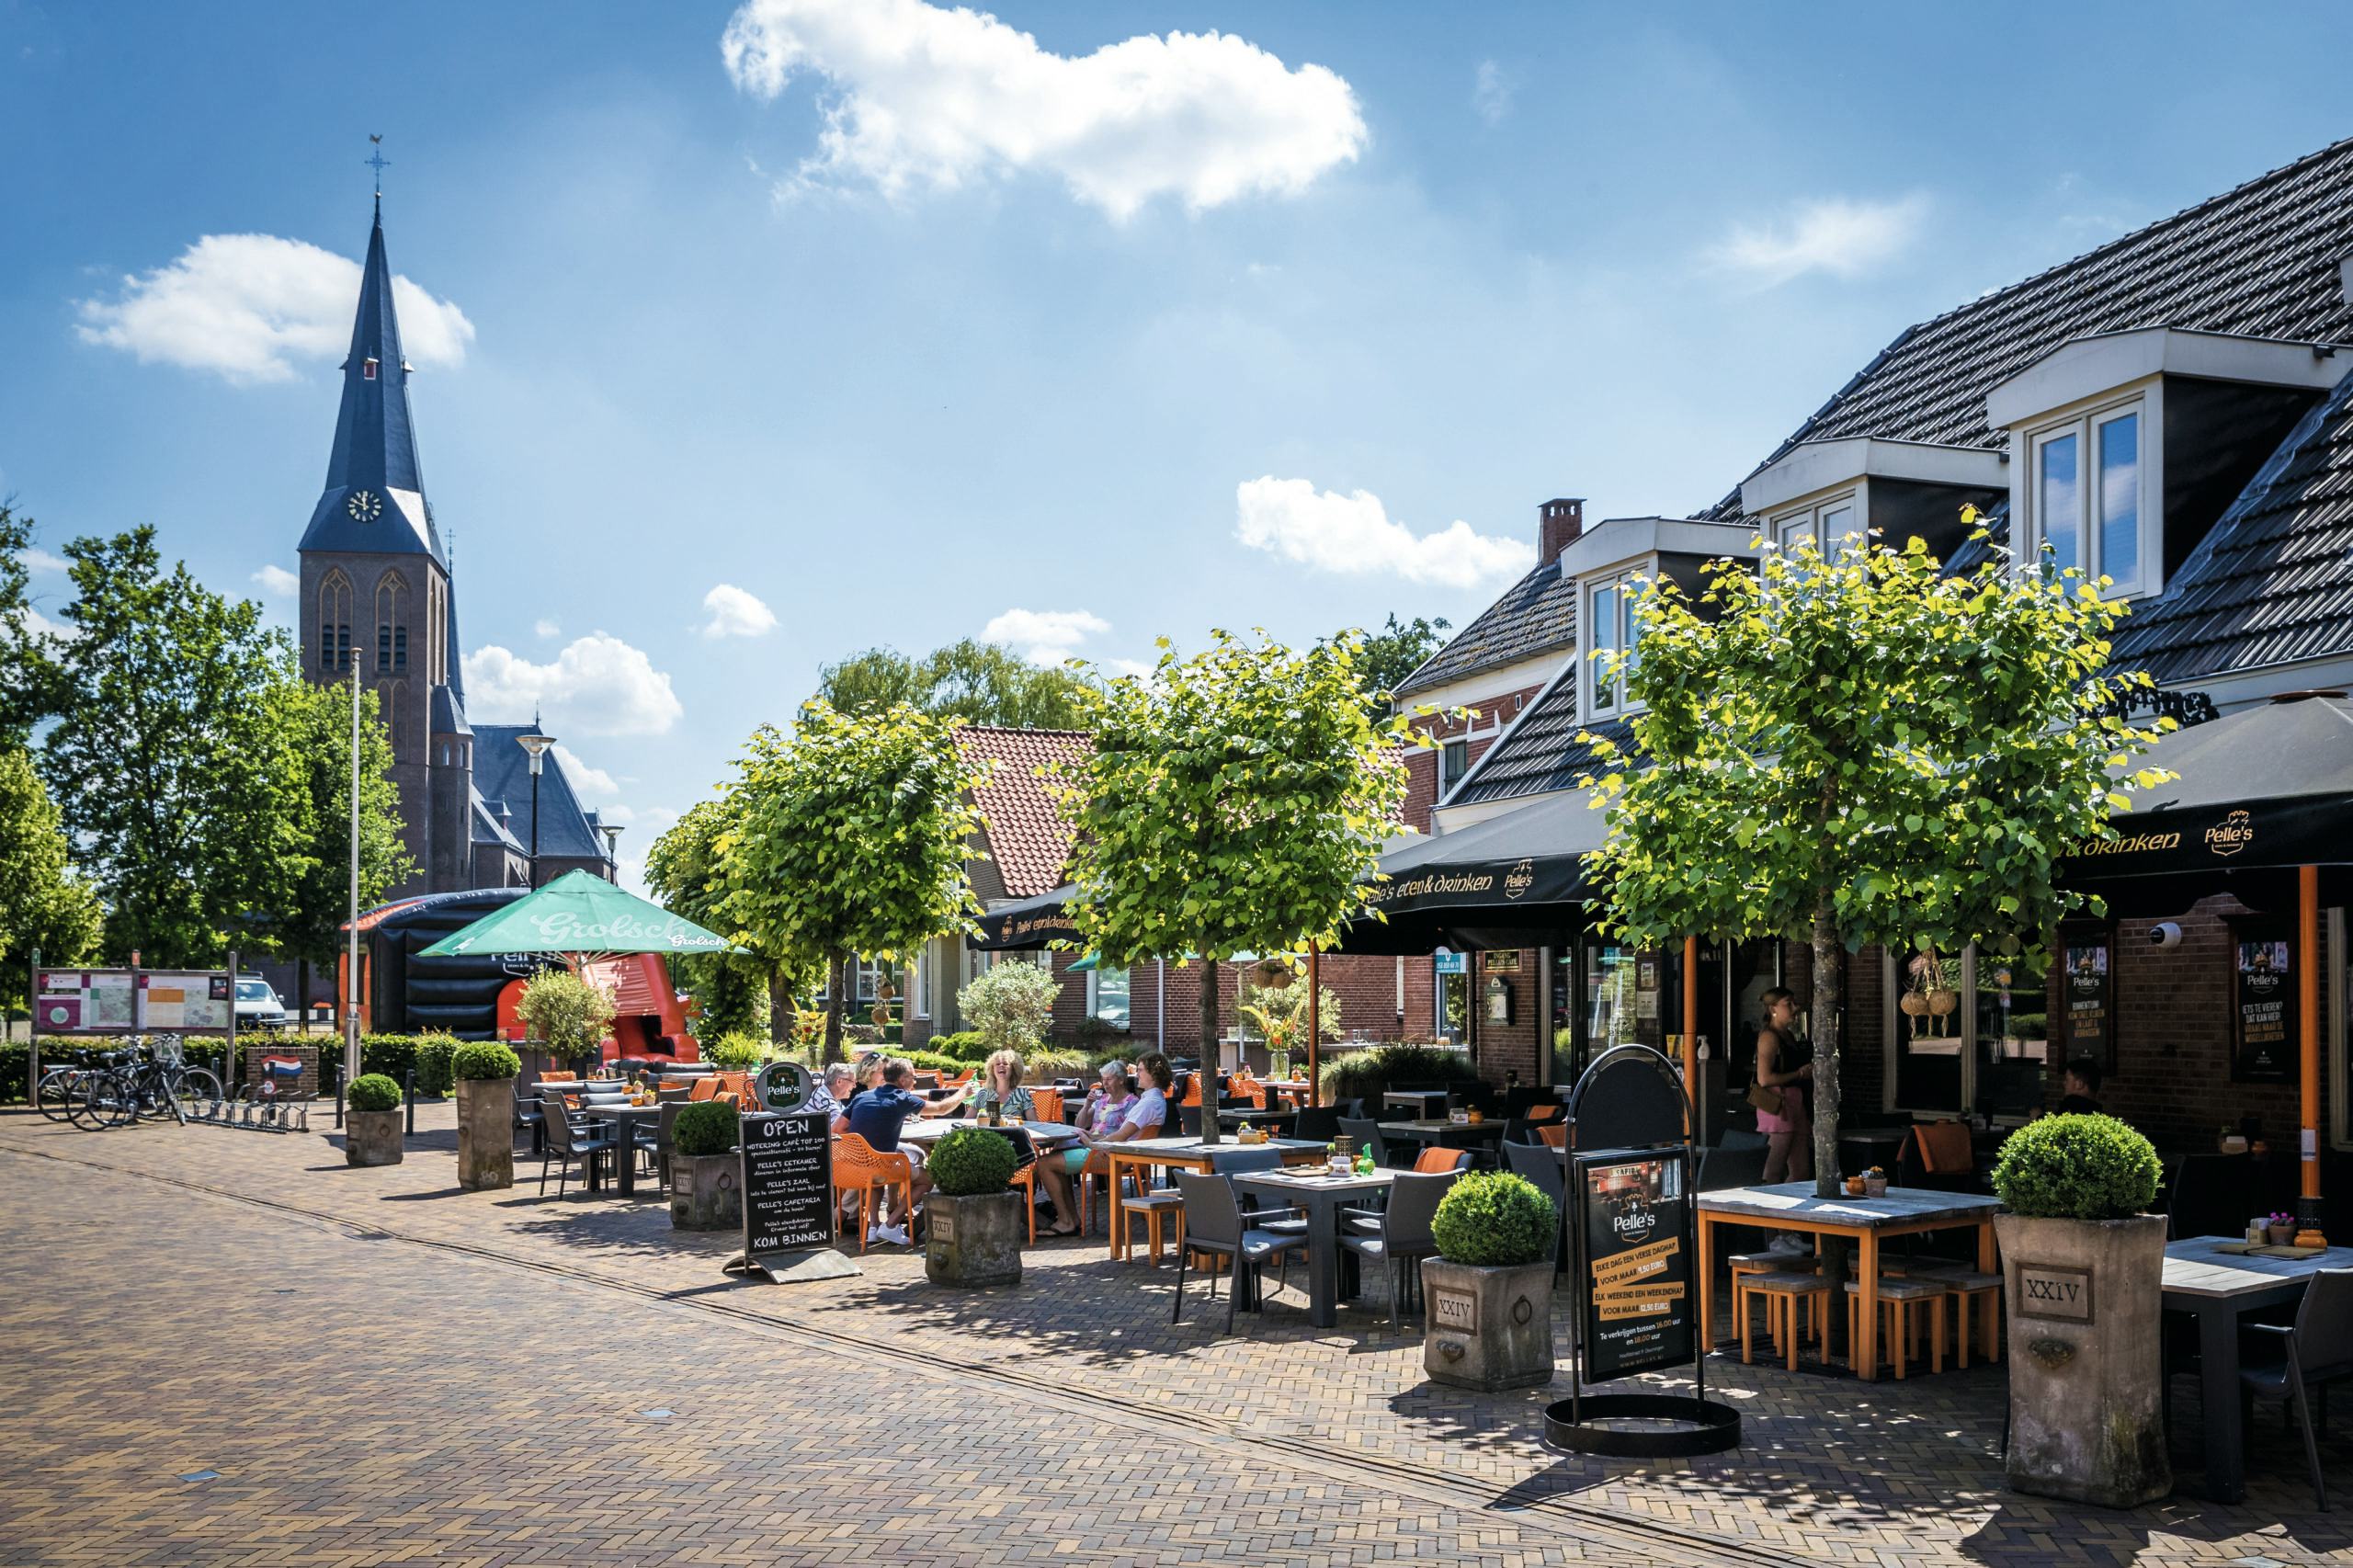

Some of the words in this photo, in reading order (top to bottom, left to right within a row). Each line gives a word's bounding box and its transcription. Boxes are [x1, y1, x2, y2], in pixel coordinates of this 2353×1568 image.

[2204, 825, 2253, 845] Pelle's
[1505, 874, 1533, 889] Pelle's
[1364, 884, 1394, 904] elle's
[530, 912, 689, 945] Grolsch
[667, 934, 728, 949] Grolsch
[2073, 977, 2099, 986] Pelle's
[2247, 974, 2279, 986] Pelle's
[767, 1085, 801, 1096] Pelle's
[763, 1119, 809, 1137] OPEN
[746, 1142, 780, 1150] NOTERING
[756, 1160, 782, 1169] PELLE'S
[784, 1157, 817, 1166] EETKAMER
[767, 1180, 791, 1188] PELLE'S
[793, 1177, 811, 1186] ZAAL
[756, 1200, 782, 1210] PELLE'S
[783, 1197, 821, 1206] CAFETARIA
[933, 1220, 951, 1234] XXIV
[1613, 1212, 1655, 1233] Pelle's
[754, 1236, 779, 1248] KOM
[782, 1230, 827, 1245] BINNEN
[1596, 1263, 1609, 1272] ELKE
[1610, 1258, 1623, 1268] DAG
[1623, 1255, 1634, 1264] EEN
[1634, 1249, 1652, 1260] VERSE
[1652, 1242, 1676, 1254] DAGHAP
[1600, 1275, 1619, 1285] VOOR
[1619, 1269, 1637, 1279] MAAR
[1651, 1259, 1665, 1270] EURO
[1595, 1291, 1605, 1301] ELK
[1607, 1290, 1634, 1300] WEEKEND
[1634, 1289, 1646, 1297] EEN
[1646, 1287, 1683, 1297] WEEKENDHAP
[2027, 1278, 2080, 1302] XXIV
[1438, 1299, 1471, 1317] XXIV
[1602, 1306, 1620, 1314] VOOR
[1621, 1305, 1640, 1313] MAAR
[1654, 1301, 1669, 1311] EURO
[1599, 1332, 1608, 1341] Te
[1608, 1328, 1636, 1338] verkrijgen
[1636, 1324, 1656, 1333] tussen
[1672, 1317, 1681, 1325] uur
[1651, 1333, 1661, 1341] uur
